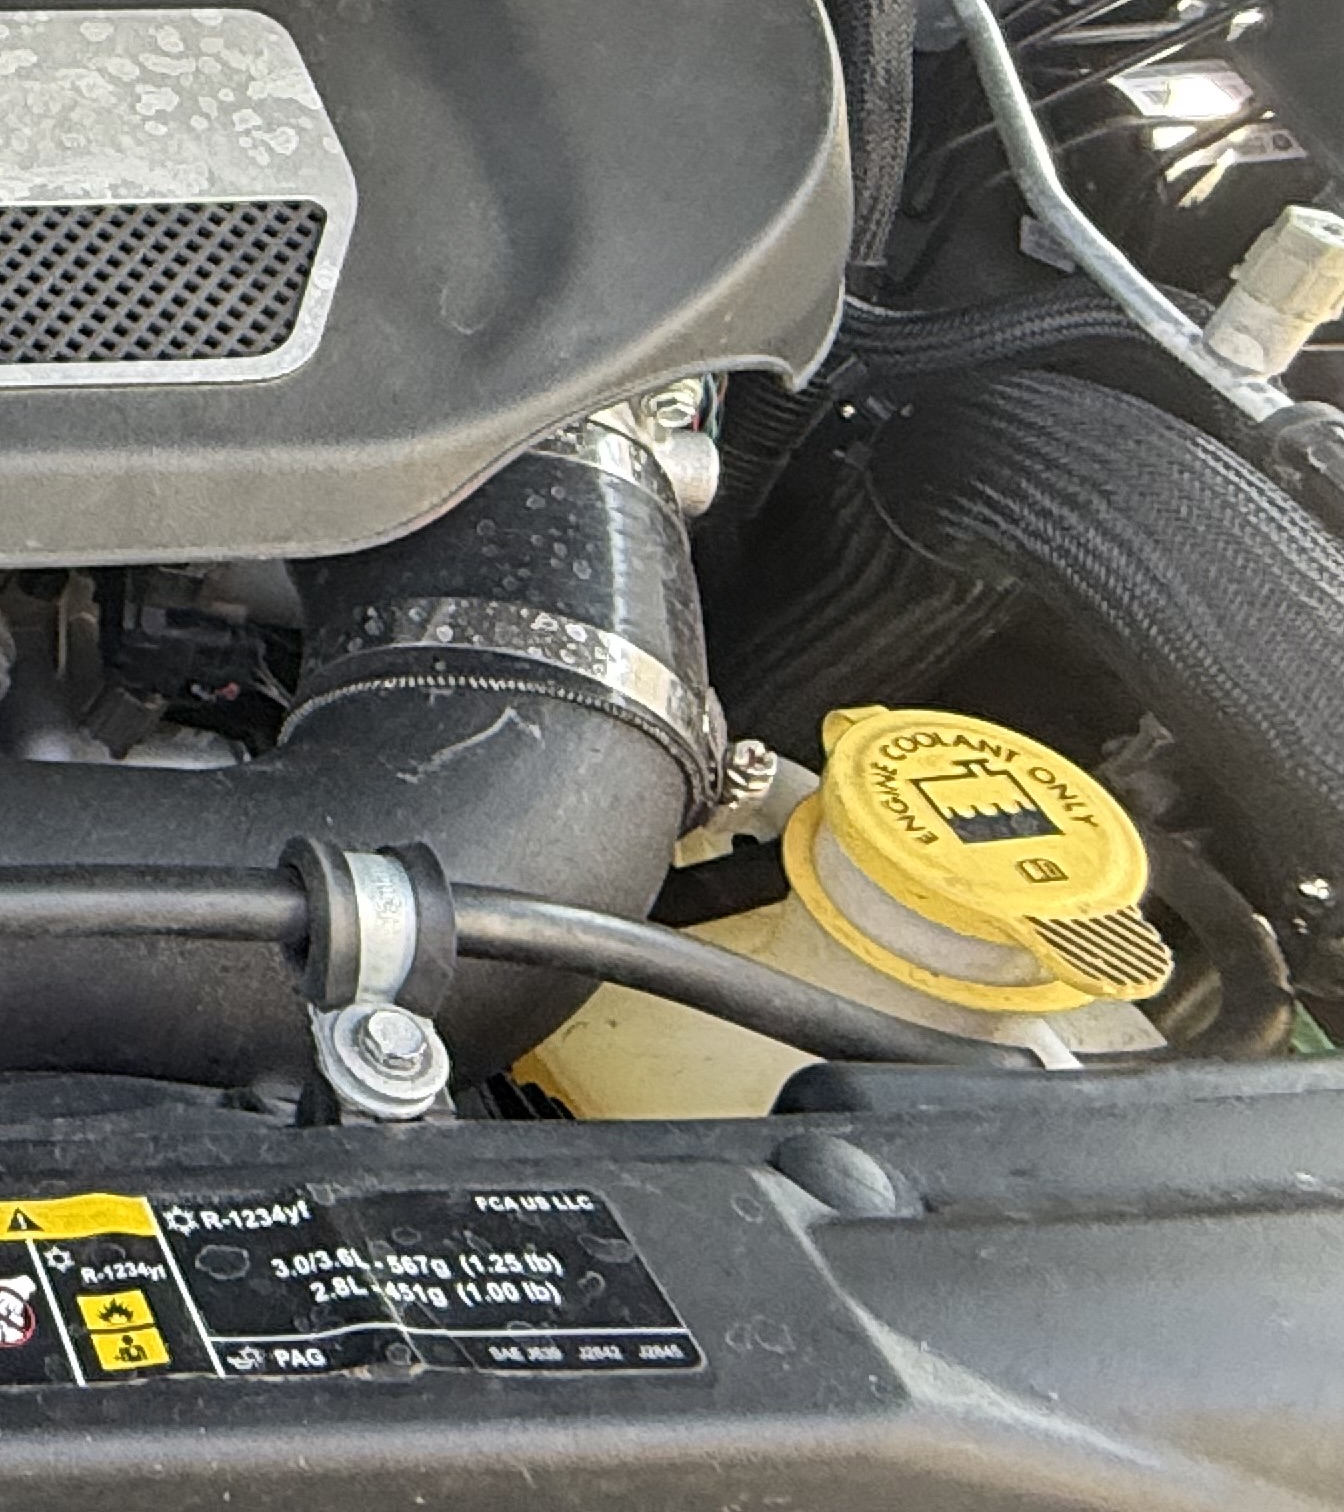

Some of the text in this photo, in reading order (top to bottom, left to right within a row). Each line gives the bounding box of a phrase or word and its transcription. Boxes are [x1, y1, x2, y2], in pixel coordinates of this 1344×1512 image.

[871, 732, 1099, 845] ENGINE COOLANT ONLY
[199, 1199, 312, 1231] R-1234yf
[474, 1194, 595, 1212] FCA US LLC
[80, 1264, 165, 1285] R-1234yf
[270, 1247, 371, 1278] 3.0/3.6L
[386, 1254, 452, 1280] 567g
[459, 1252, 522, 1279] (1.25
[523, 1252, 563, 1278] lb)
[309, 1275, 369, 1303] 2.8L
[385, 1281, 449, 1309] 451g
[456, 1281, 518, 1308] (1.00
[521, 1280, 562, 1306] lb)
[272, 1347, 328, 1368] PAG
